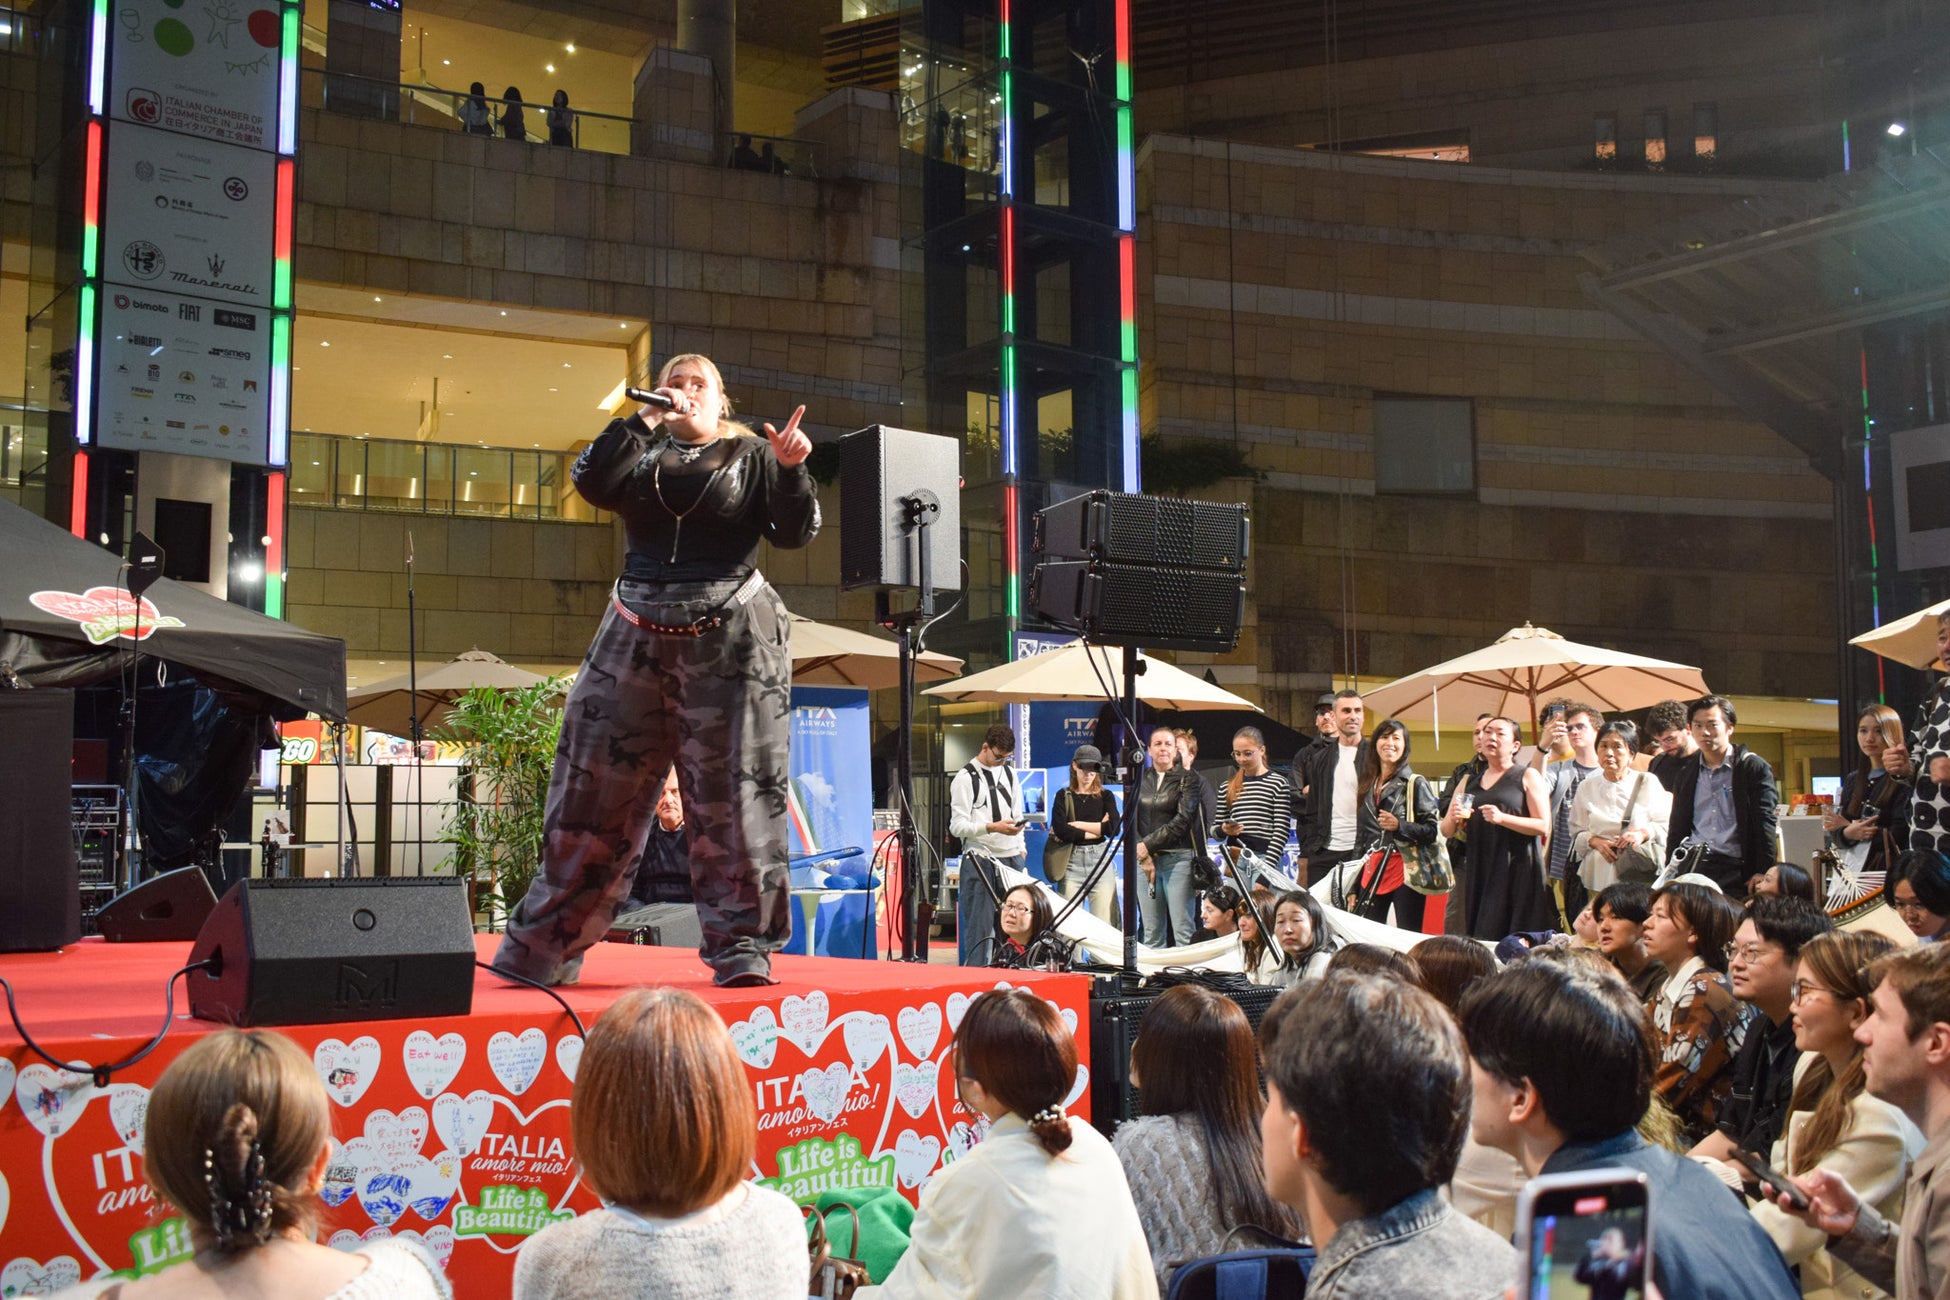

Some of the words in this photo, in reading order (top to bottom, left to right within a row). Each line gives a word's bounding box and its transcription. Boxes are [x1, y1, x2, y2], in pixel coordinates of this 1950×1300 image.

[165, 106, 218, 126] COMMERCE
[220, 118, 231, 128] IN
[234, 120, 263, 135] JAPAN
[166, 96, 202, 110] ITALIAN
[203, 104, 249, 122] CHAMBER
[251, 114, 264, 125] OF
[169, 270, 260, 295] Maserati
[132, 300, 169, 314] bimota
[179, 303, 201, 322] FIAT
[133, 334, 162, 348] BIALETTI
[222, 350, 251, 361] smeg
[796, 706, 837, 720] ITA
[799, 719, 836, 728] AIRWAYS
[408, 1048, 431, 1060] Eat
[757, 1105, 817, 1132] amor
[471, 1156, 526, 1173] amore
[529, 1156, 575, 1176] mio!
[783, 1142, 835, 1178] Life
[839, 1138, 856, 1160] is
[492, 1173, 542, 1183] イタリアンフェス
[762, 1160, 889, 1199] eautiful
[483, 1188, 526, 1210] Life
[528, 1191, 544, 1208] is
[137, 1221, 195, 1267] Lif
